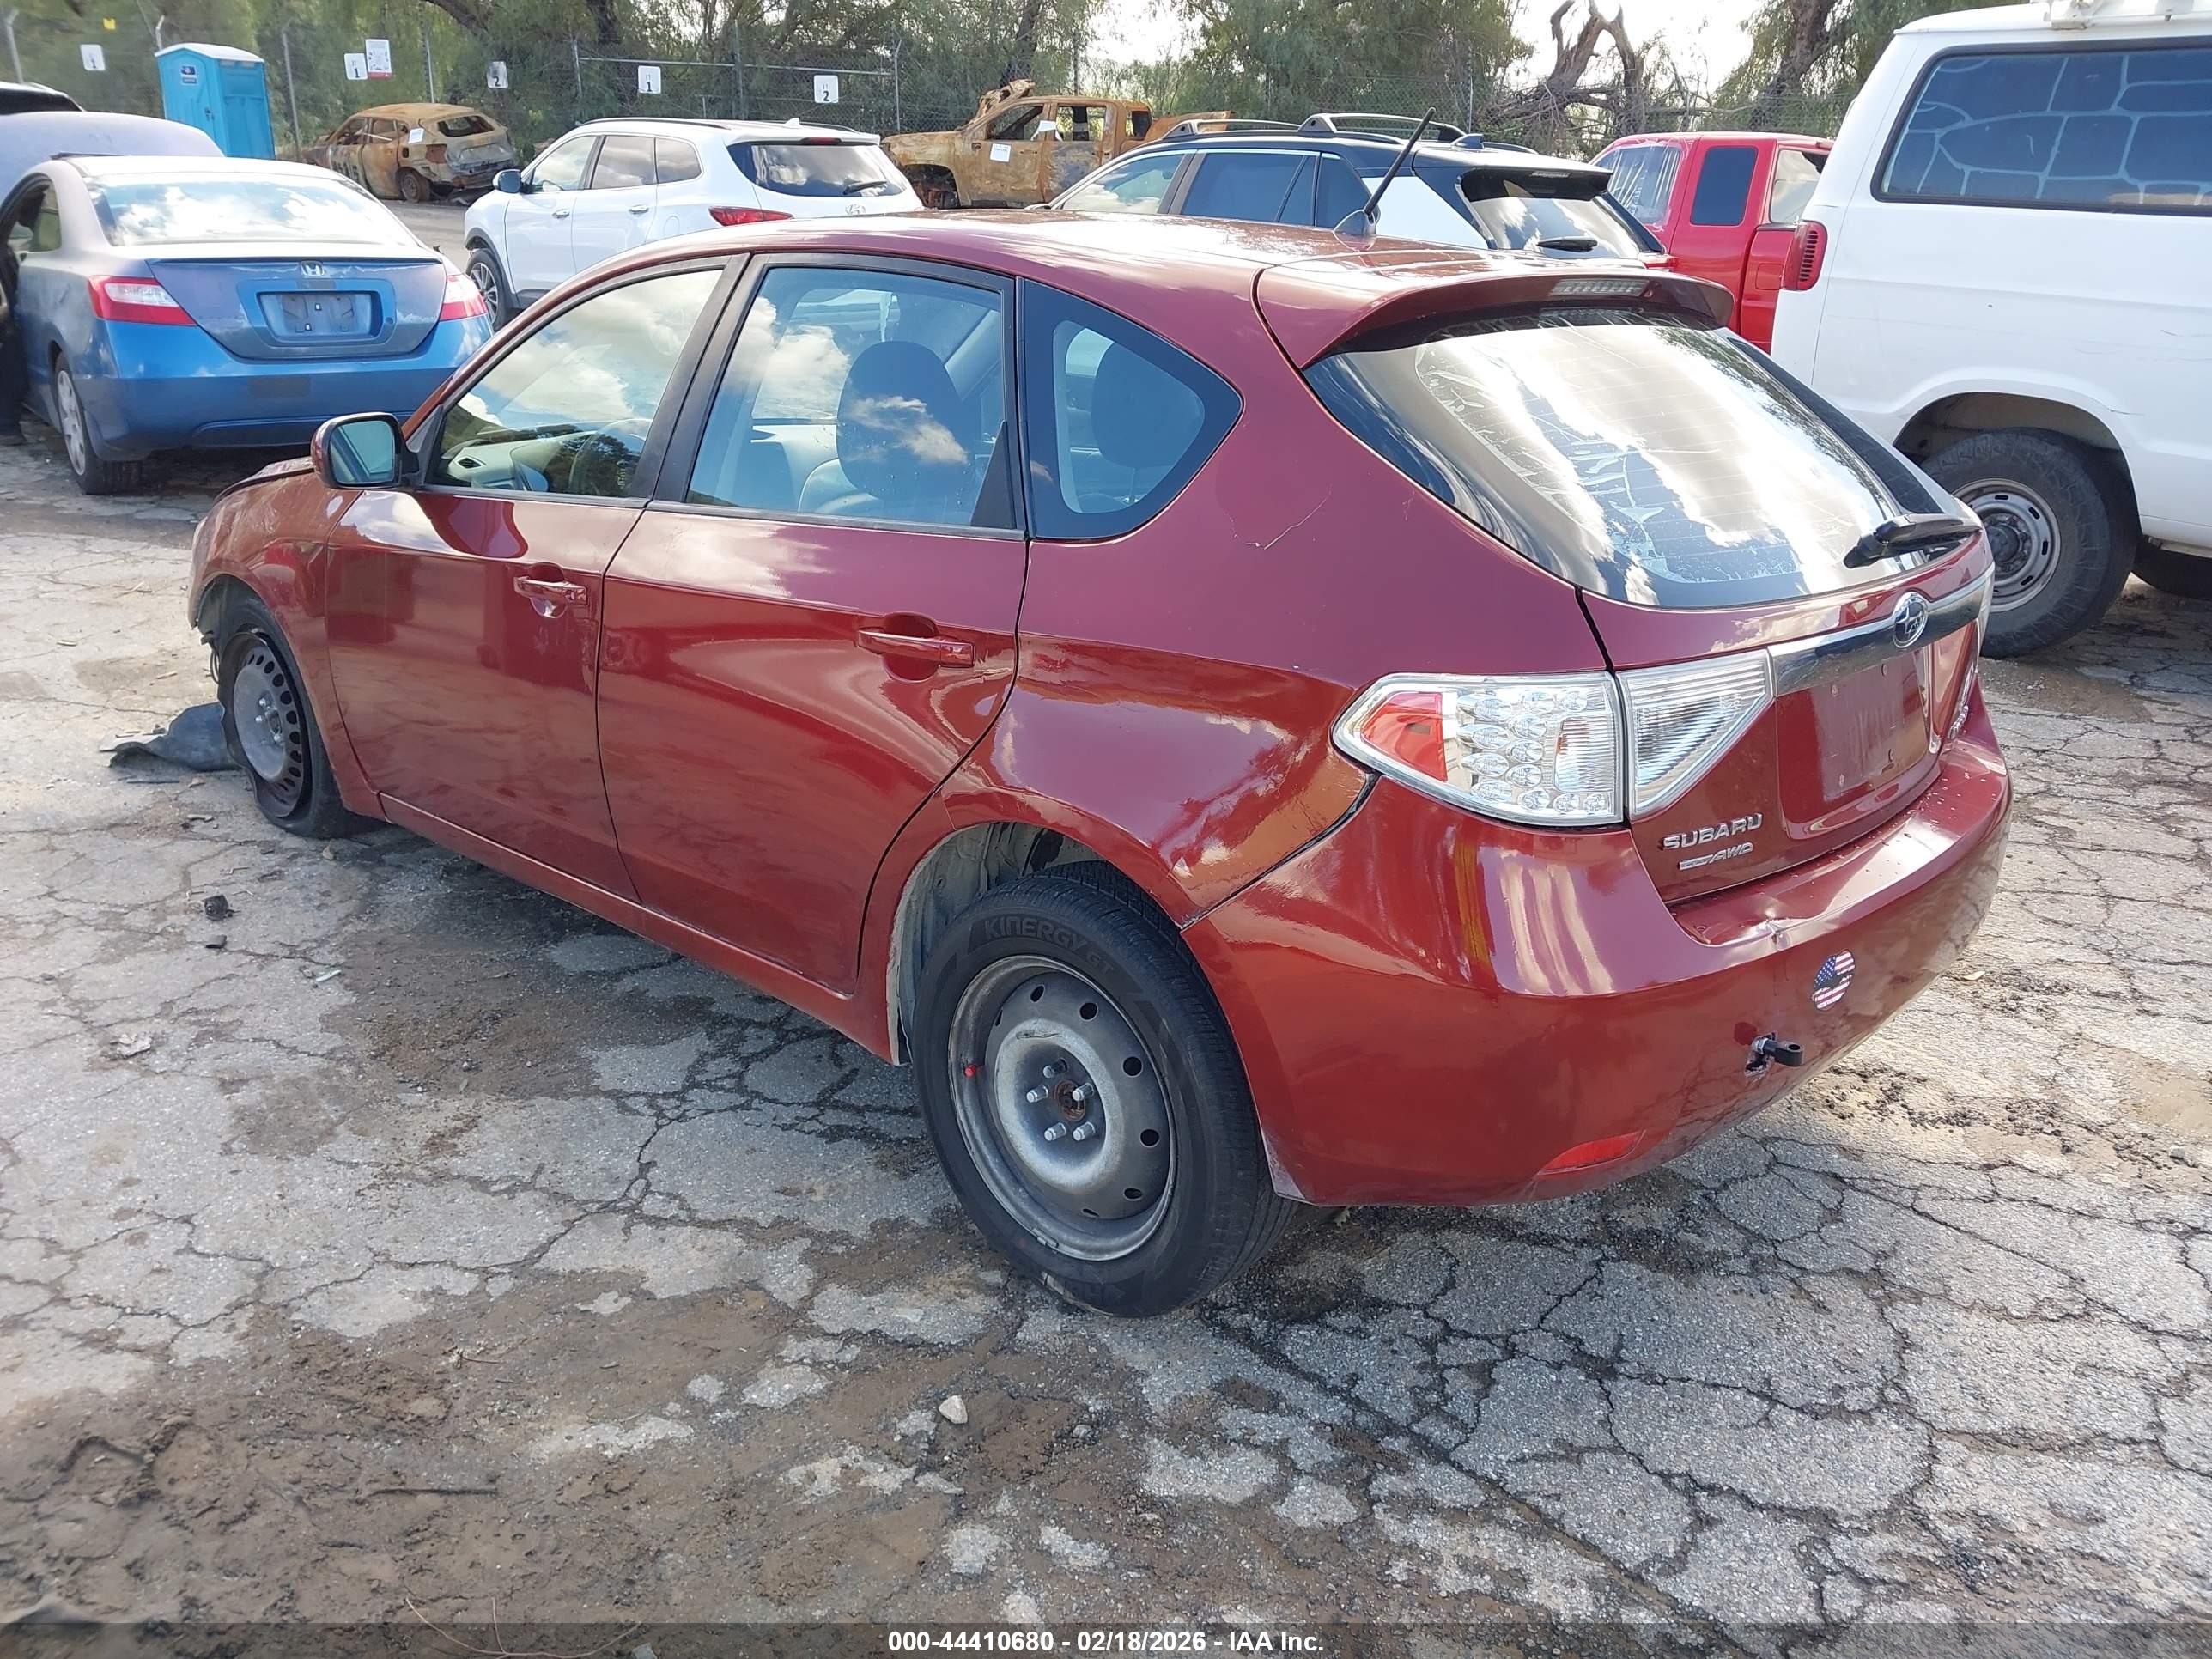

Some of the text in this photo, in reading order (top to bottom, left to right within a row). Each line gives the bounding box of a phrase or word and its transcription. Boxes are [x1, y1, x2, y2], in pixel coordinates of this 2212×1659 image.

[354, 68, 360, 78] 1
[492, 76, 501, 87] 2
[646, 82, 653, 92] 1
[823, 90, 830, 102] 2
[1663, 812, 1763, 849] SUBARU
[1709, 842, 1753, 863] AWD
[1085, 951, 1114, 974] GT
